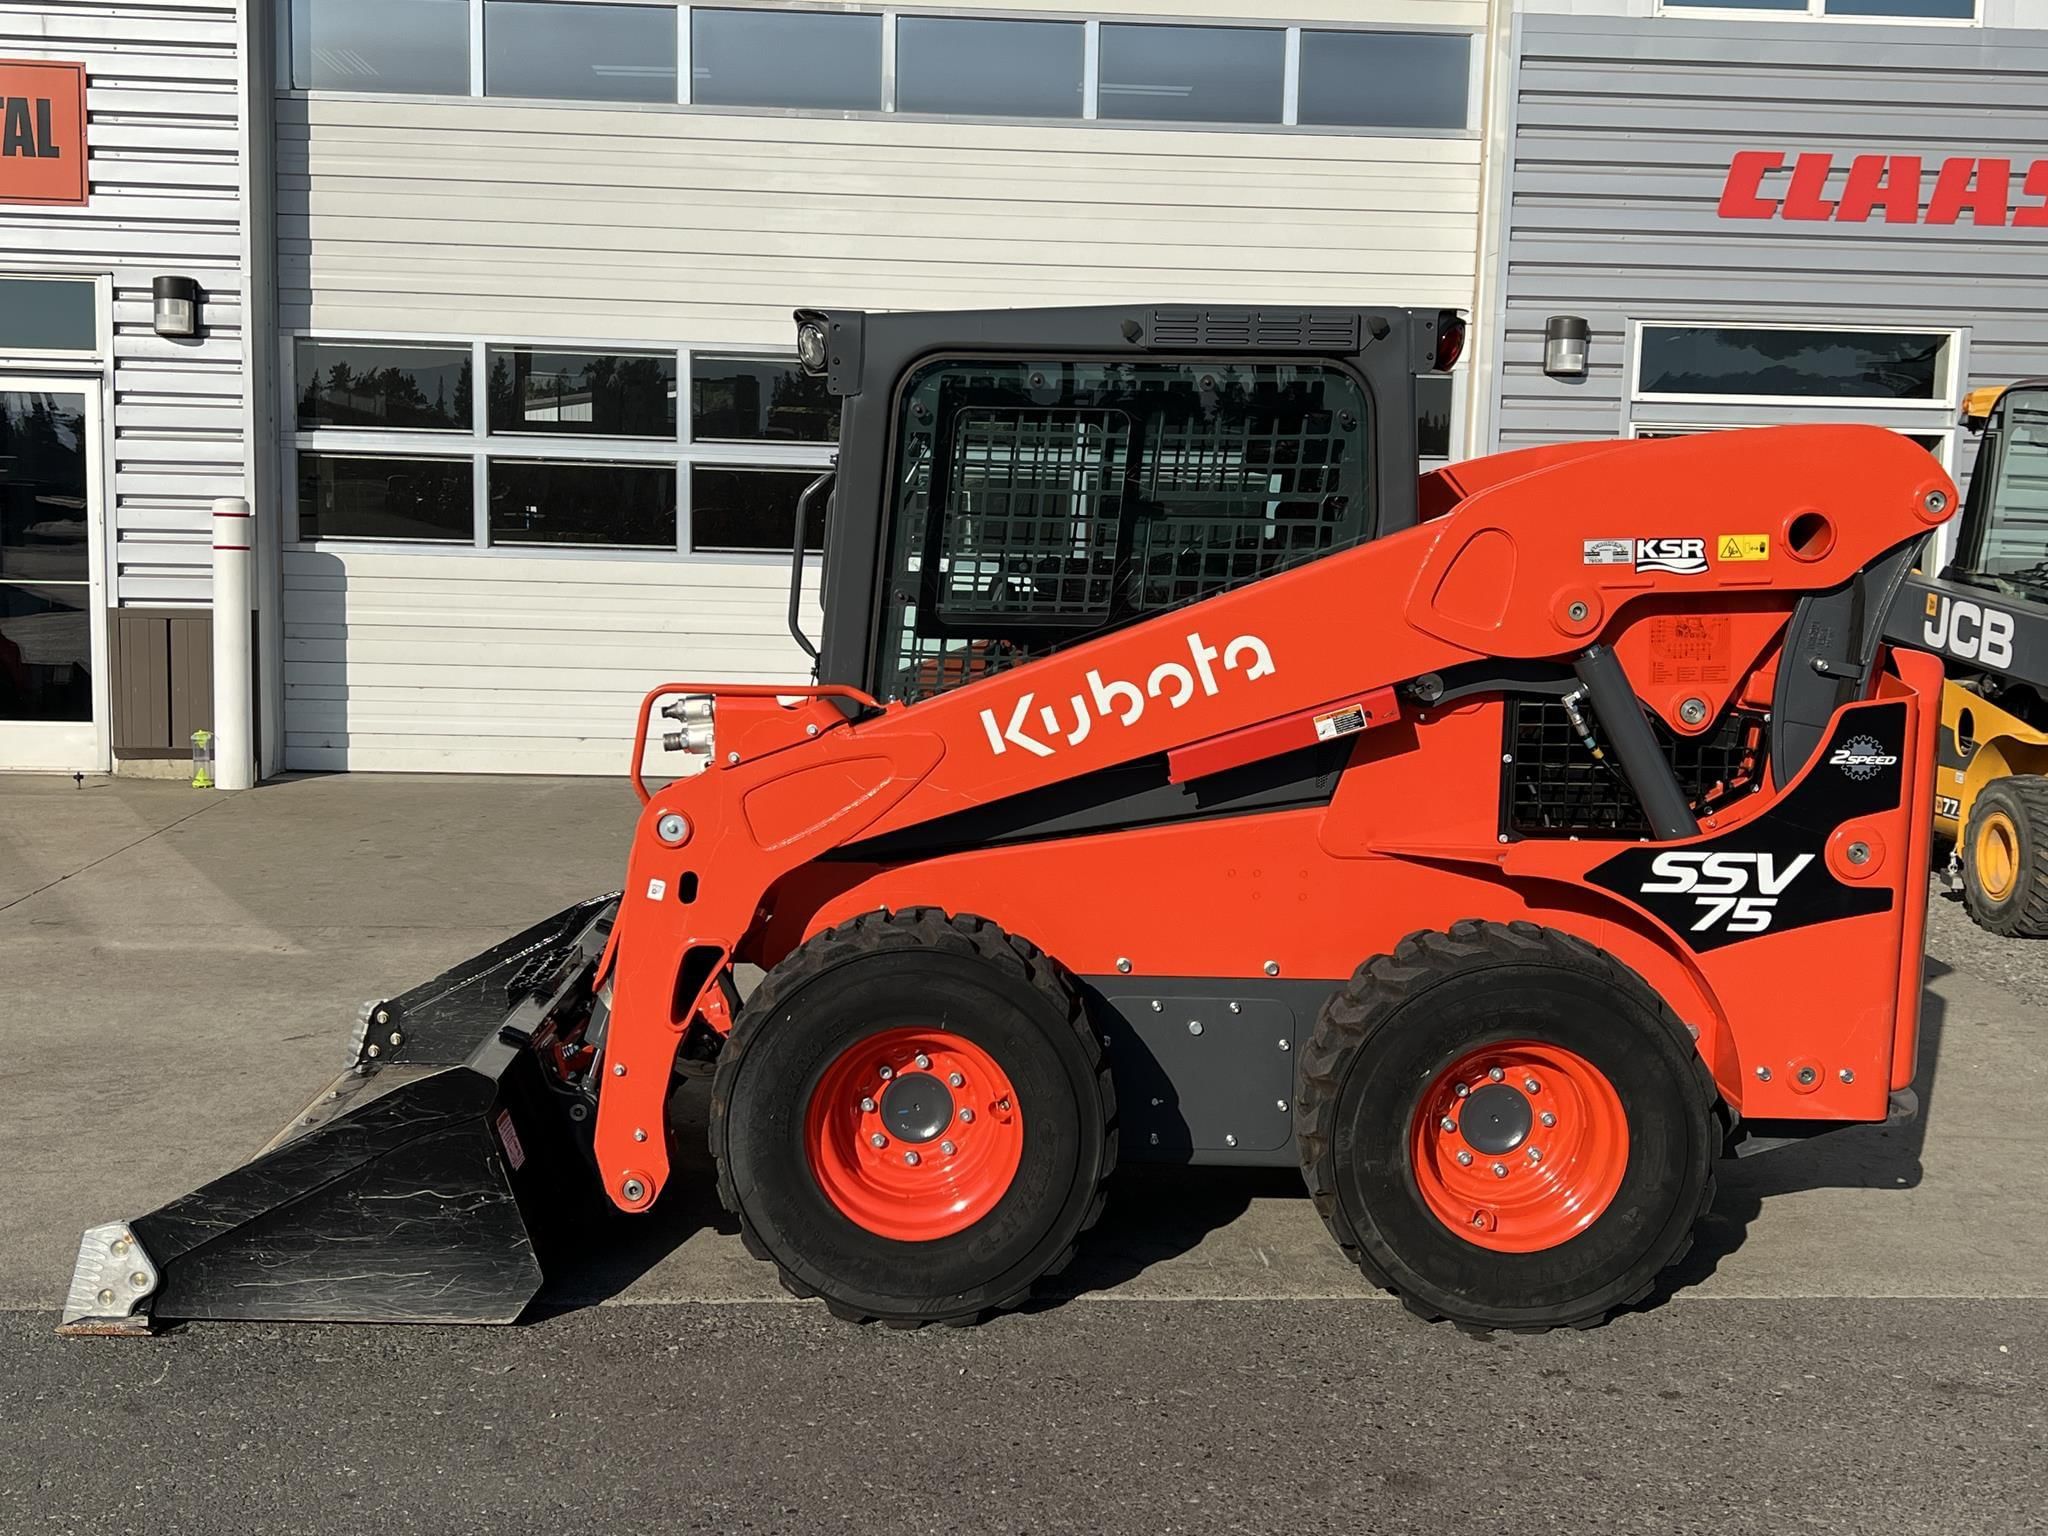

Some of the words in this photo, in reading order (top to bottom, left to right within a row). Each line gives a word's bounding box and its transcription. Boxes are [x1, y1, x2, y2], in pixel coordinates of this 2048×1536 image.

[0, 97, 60, 158] AL
[1637, 539, 1705, 558] KSR
[1923, 597, 2015, 669] JCB
[979, 632, 1276, 757] Kubota
[1640, 851, 1816, 895] SSV
[1690, 897, 1778, 932] 75
